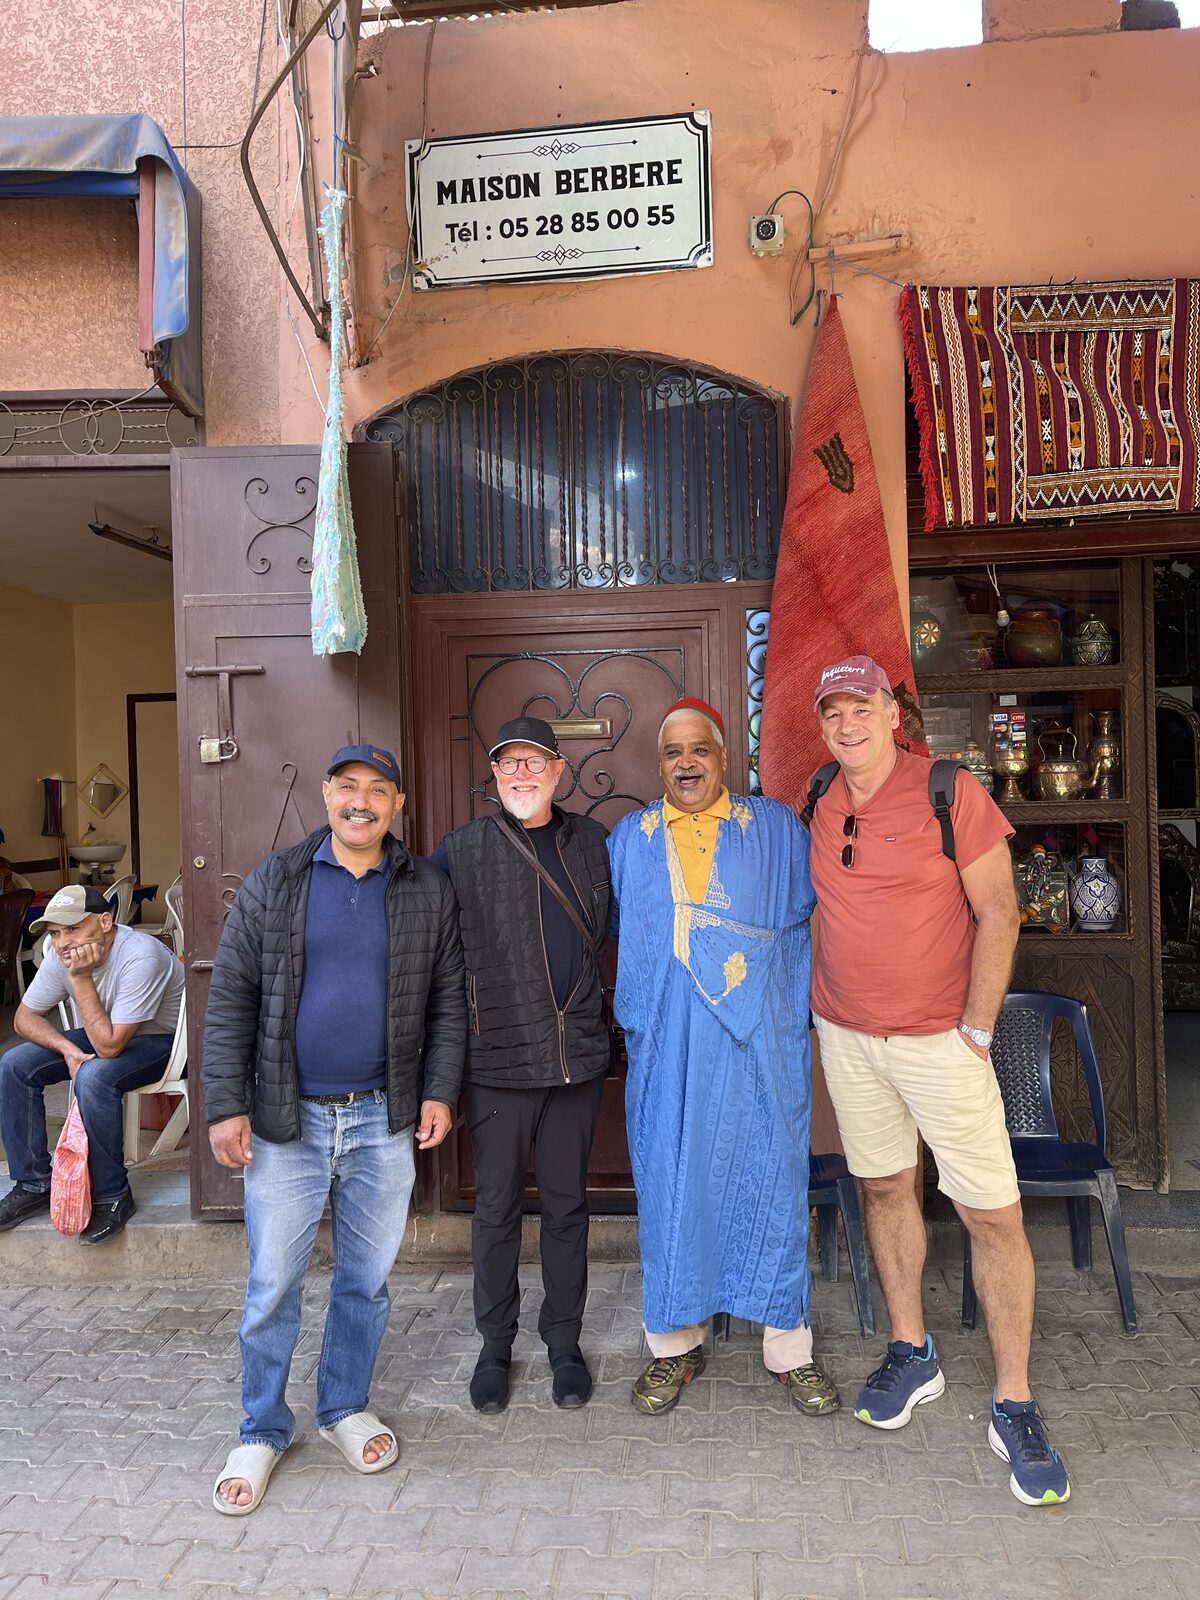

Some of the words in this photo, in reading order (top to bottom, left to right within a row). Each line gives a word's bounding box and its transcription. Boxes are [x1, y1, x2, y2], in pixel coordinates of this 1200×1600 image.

[436, 172, 541, 206] MAISON
[555, 159, 683, 195] BERBERE
[445, 220, 478, 244] Tél
[499, 217, 529, 240] 05
[535, 213, 564, 236] 28
[571, 211, 600, 233] 85
[606, 207, 640, 230] 00
[646, 204, 675, 226] 55
